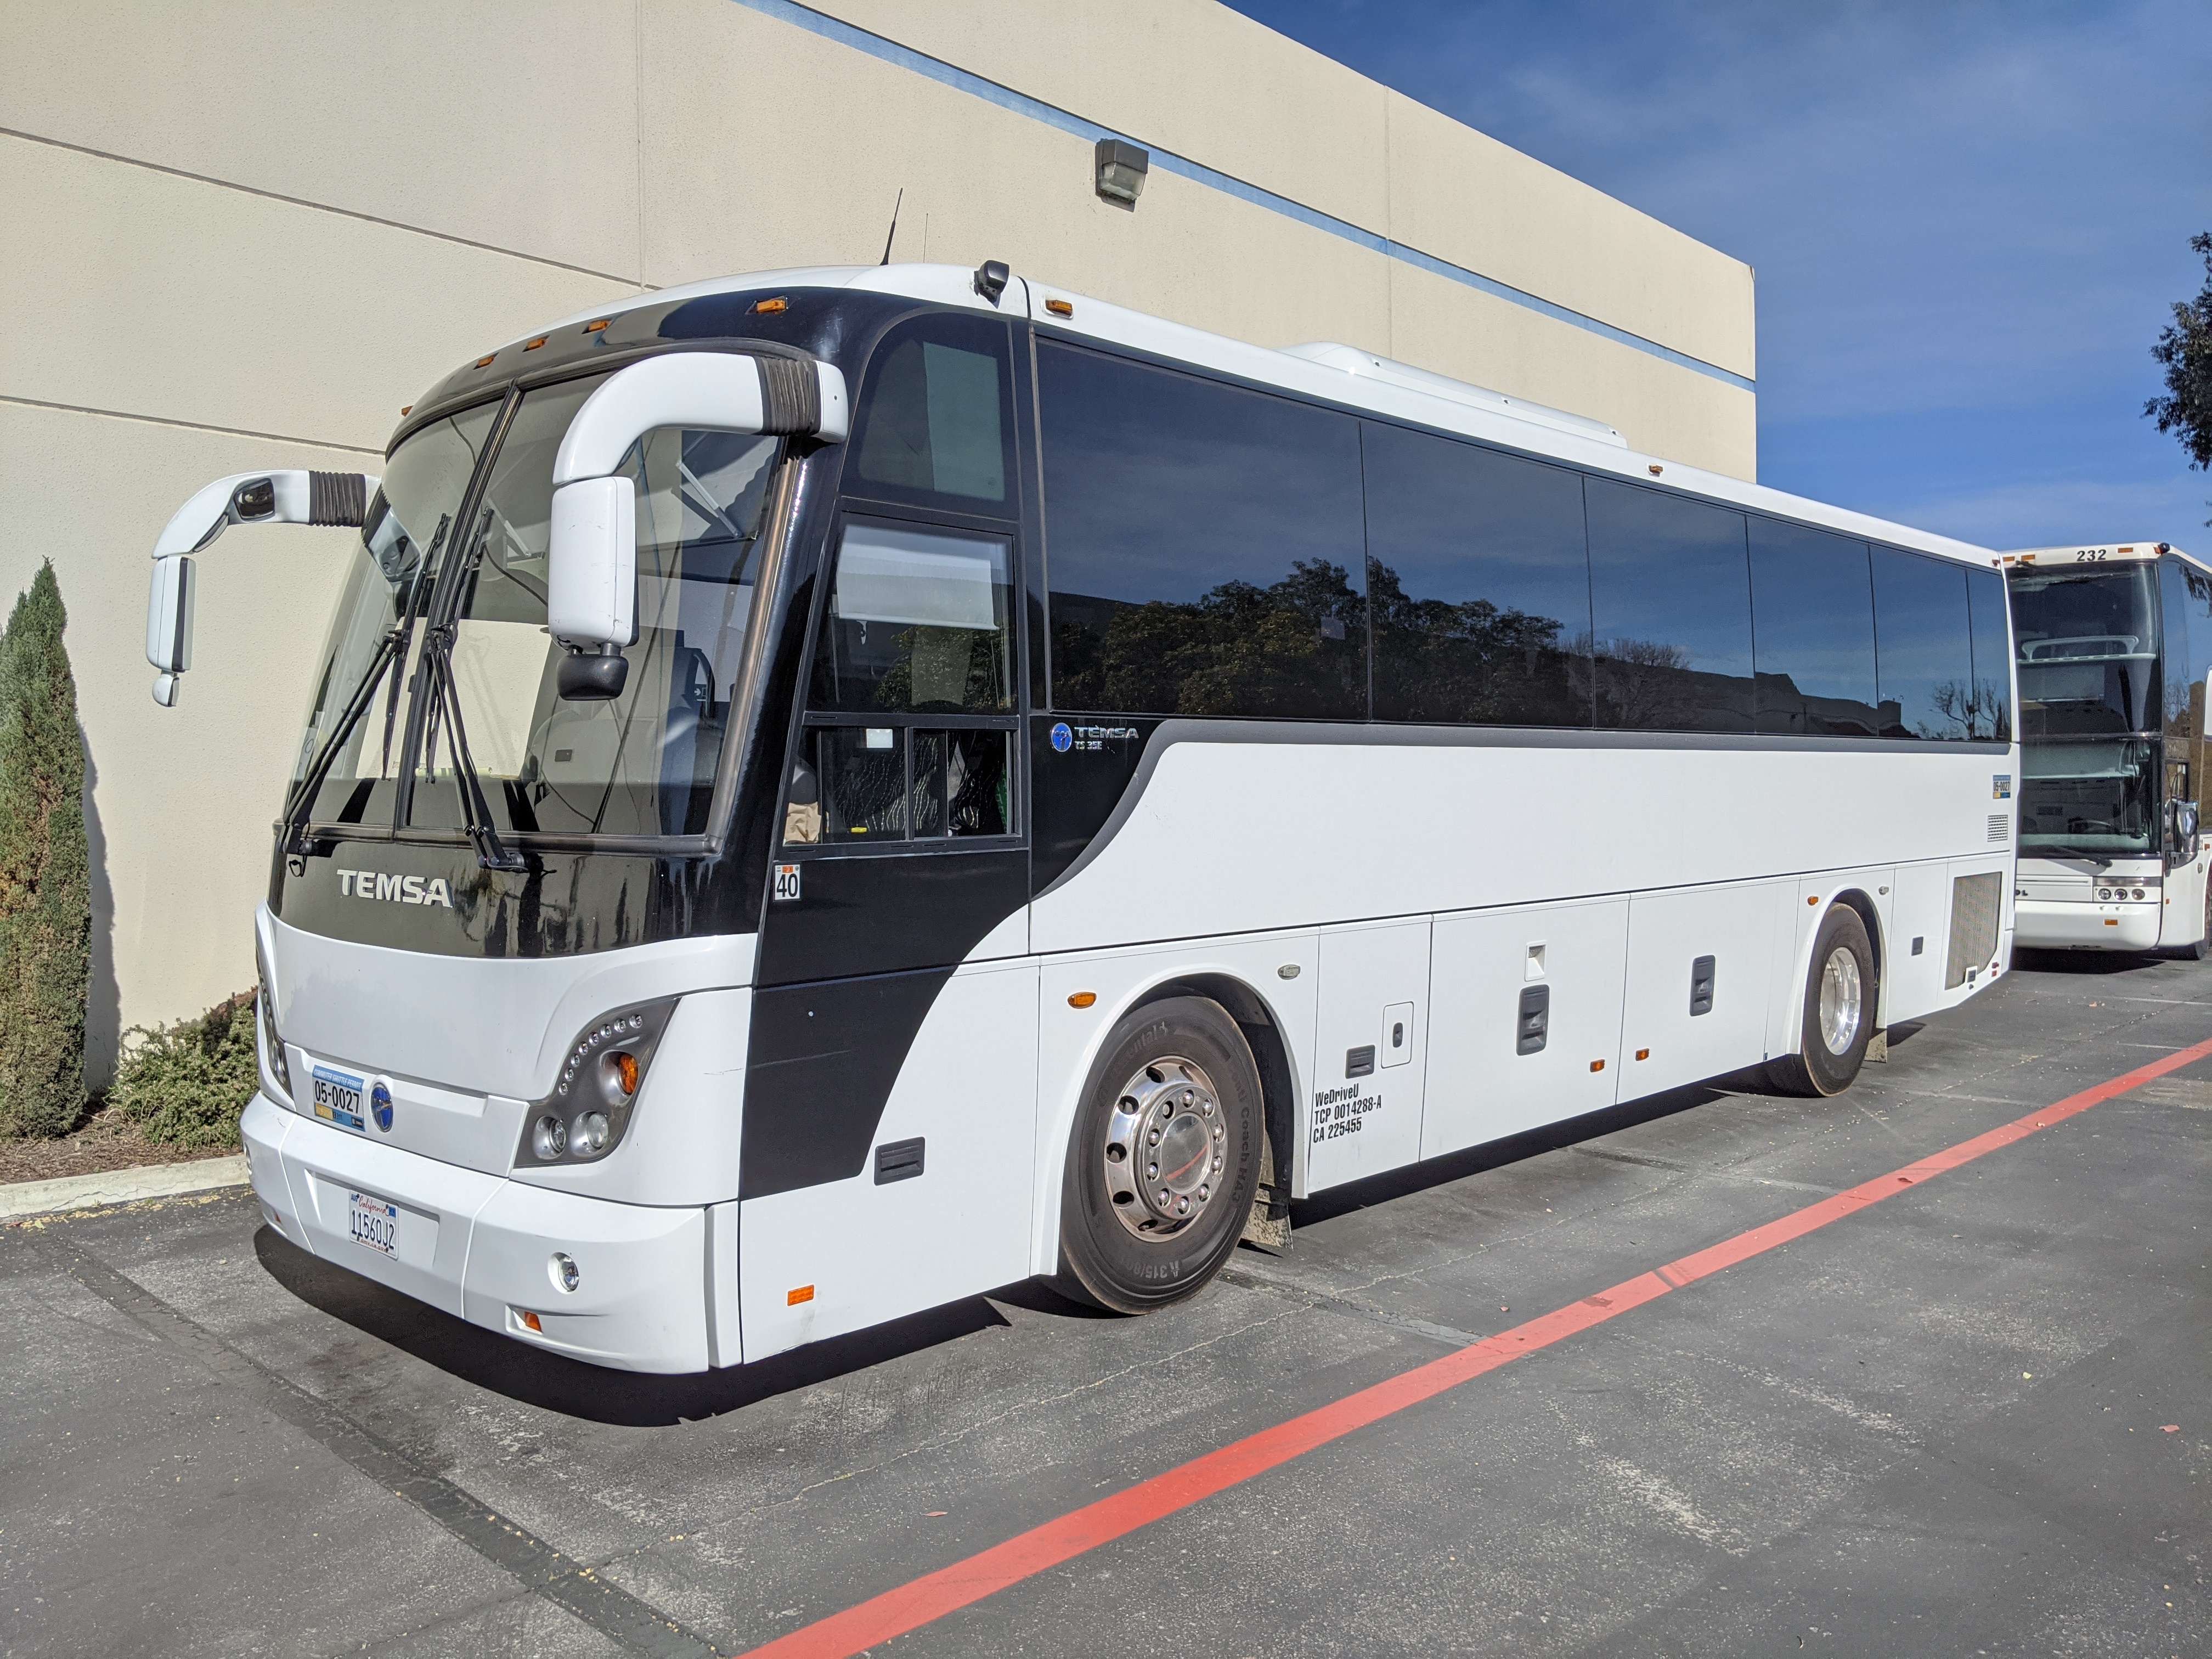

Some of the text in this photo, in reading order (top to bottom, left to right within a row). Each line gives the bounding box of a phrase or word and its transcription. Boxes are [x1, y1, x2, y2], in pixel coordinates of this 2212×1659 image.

[2076, 549, 2107, 562] 232
[1074, 726, 1139, 739] TEMSA
[1074, 741, 1085, 750] TS
[337, 869, 454, 908] TEMSA
[776, 873, 798, 898] 40
[315, 1080, 359, 1114] 05-0027
[1315, 1082, 1359, 1108] WeDriveU
[1314, 1094, 1382, 1125] TCP 0014288-A
[1313, 1116, 1362, 1143] CA 225455
[359, 1195, 390, 1216] California
[351, 1209, 394, 1250] 11560J2
